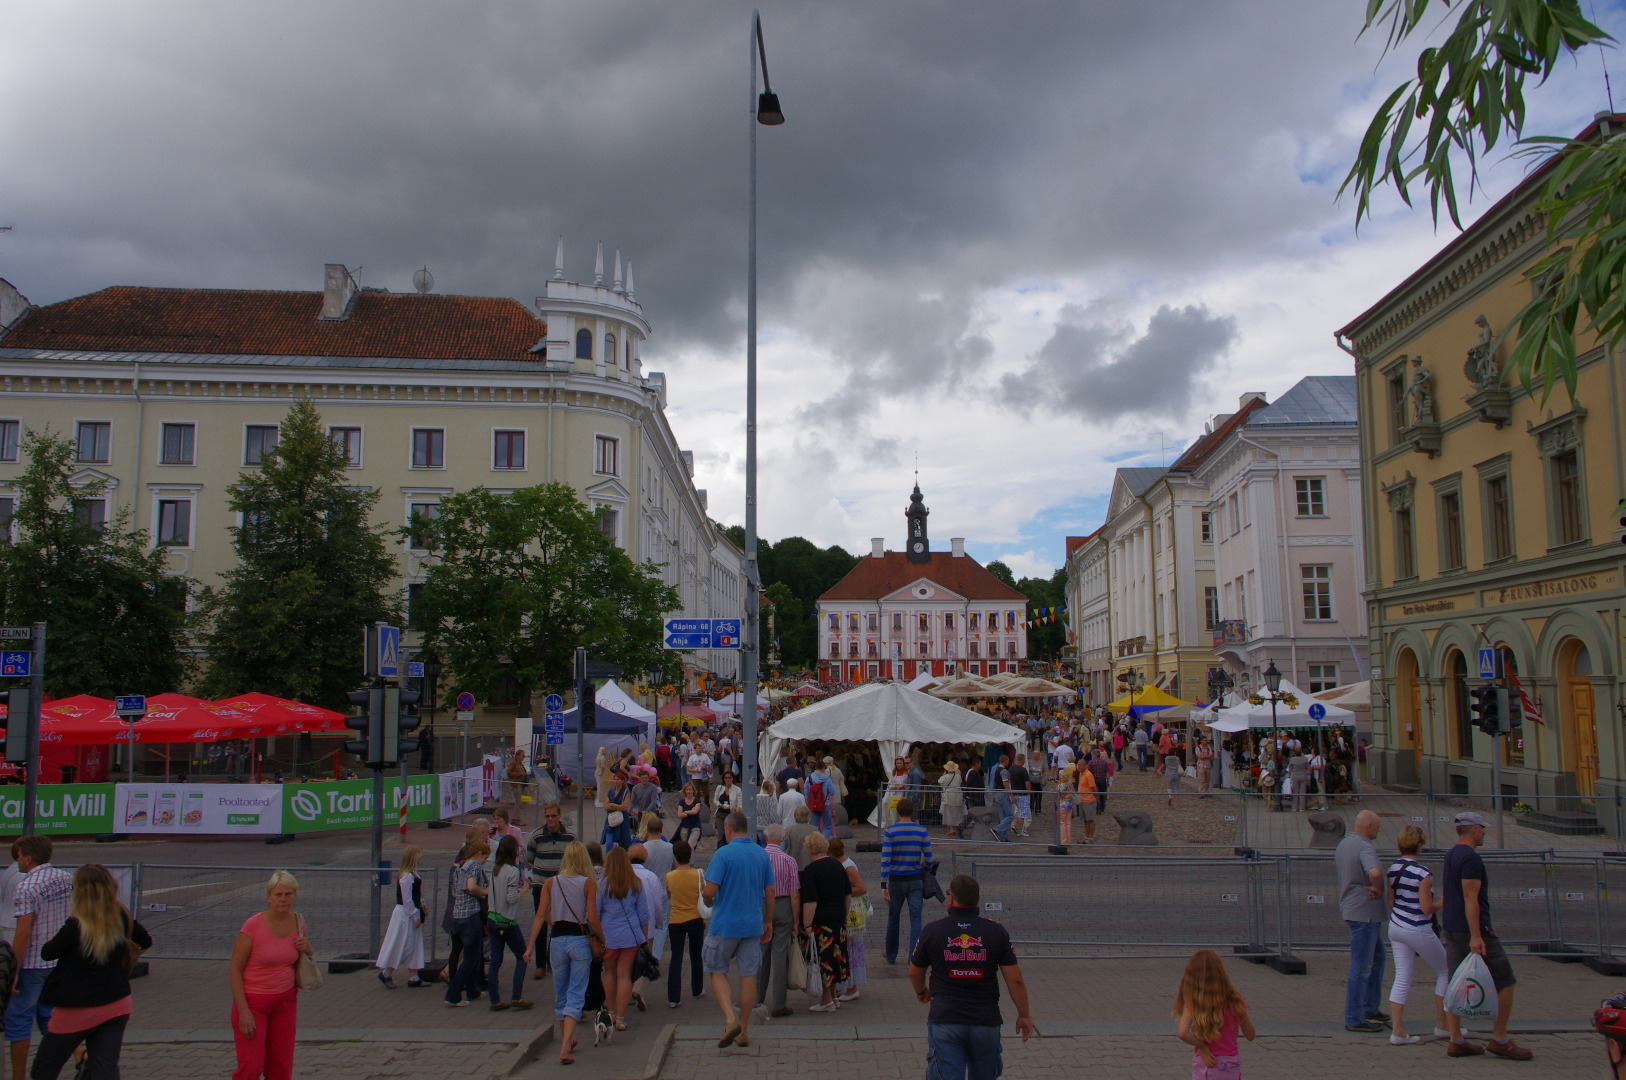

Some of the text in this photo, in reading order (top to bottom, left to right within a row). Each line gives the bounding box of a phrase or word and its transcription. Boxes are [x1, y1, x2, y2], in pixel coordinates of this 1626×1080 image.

[0, 629, 28, 637] ELINN
[672, 637, 709, 645] Ahja 38
[393, 783, 431, 808] Mill
[62, 793, 106, 817] Mill
[218, 797, 271, 806] Pooltooted
[944, 949, 987, 962] Red Bull
